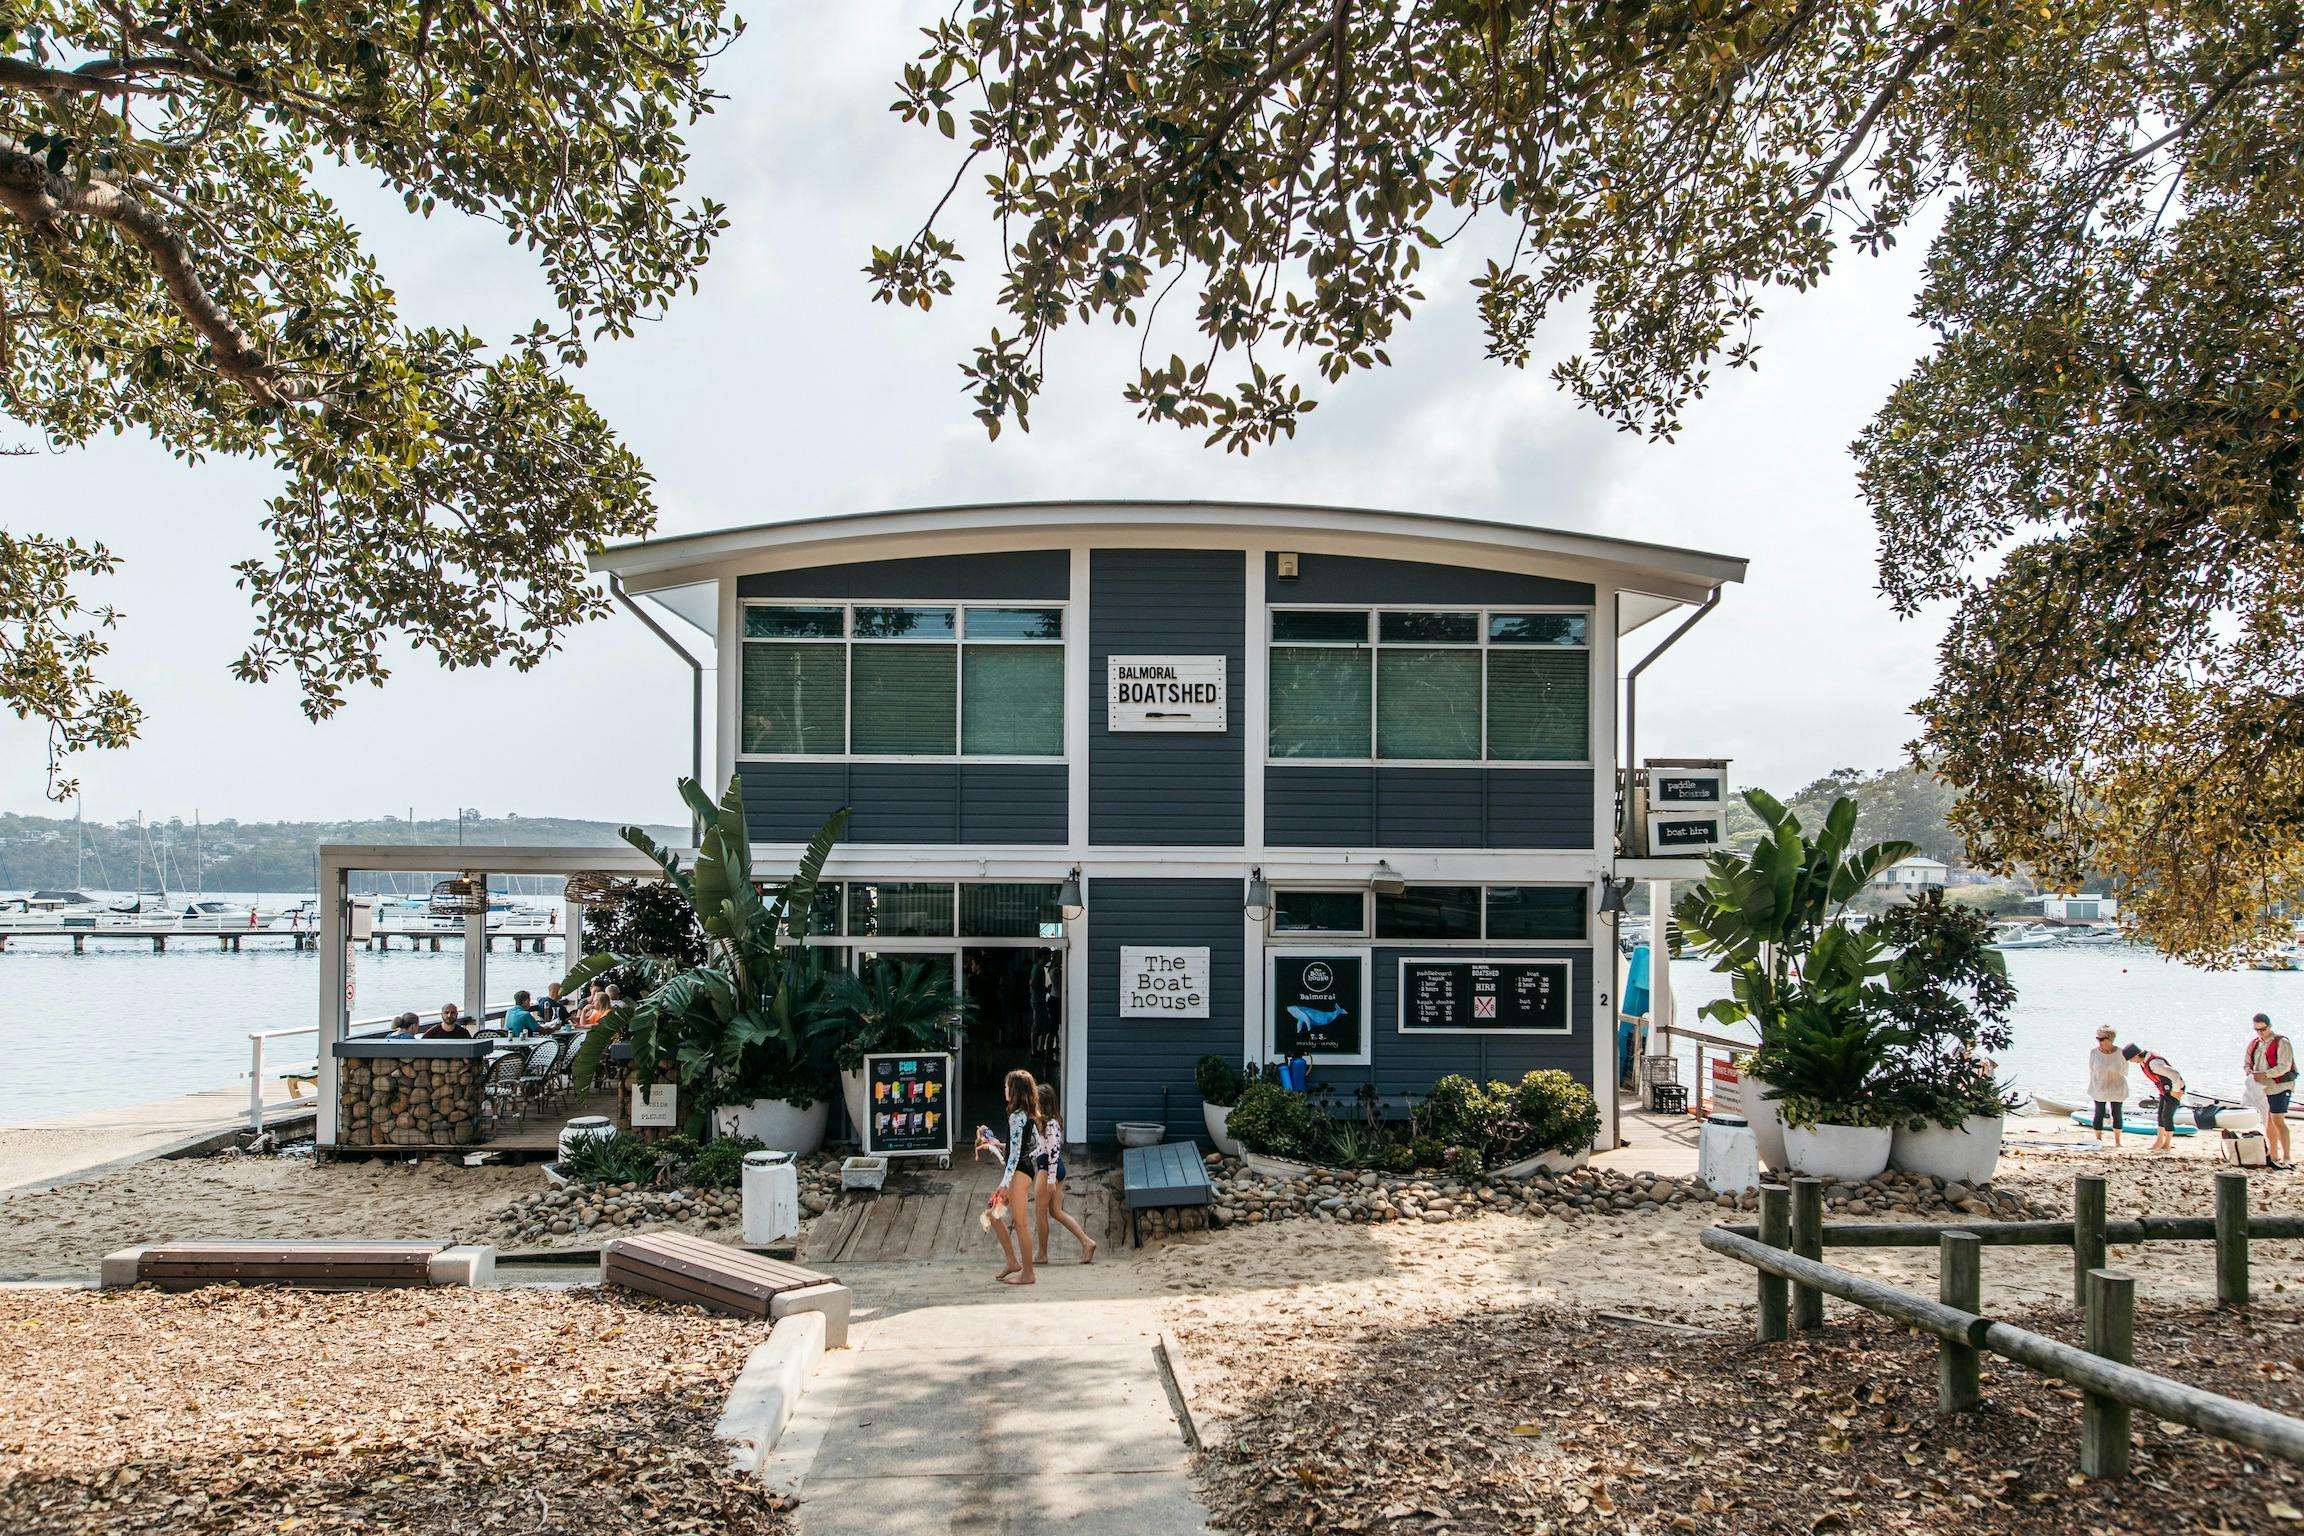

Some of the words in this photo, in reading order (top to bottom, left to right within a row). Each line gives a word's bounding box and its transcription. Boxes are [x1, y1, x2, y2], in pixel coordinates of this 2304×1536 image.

[1119, 667, 1177, 679] BALMORAL
[1119, 683, 1217, 703] BOATSHED
[1667, 781, 1696, 792] paddle
[1666, 828, 1687, 836] boat
[1689, 827, 1709, 835] hire
[1145, 955, 1185, 971] The
[1472, 969, 1499, 977] BOATSHED
[1138, 974, 1193, 990] Boat
[1475, 983, 1496, 991] HIRE
[1131, 992, 1200, 1009] house
[1600, 993, 1608, 1006] 2
